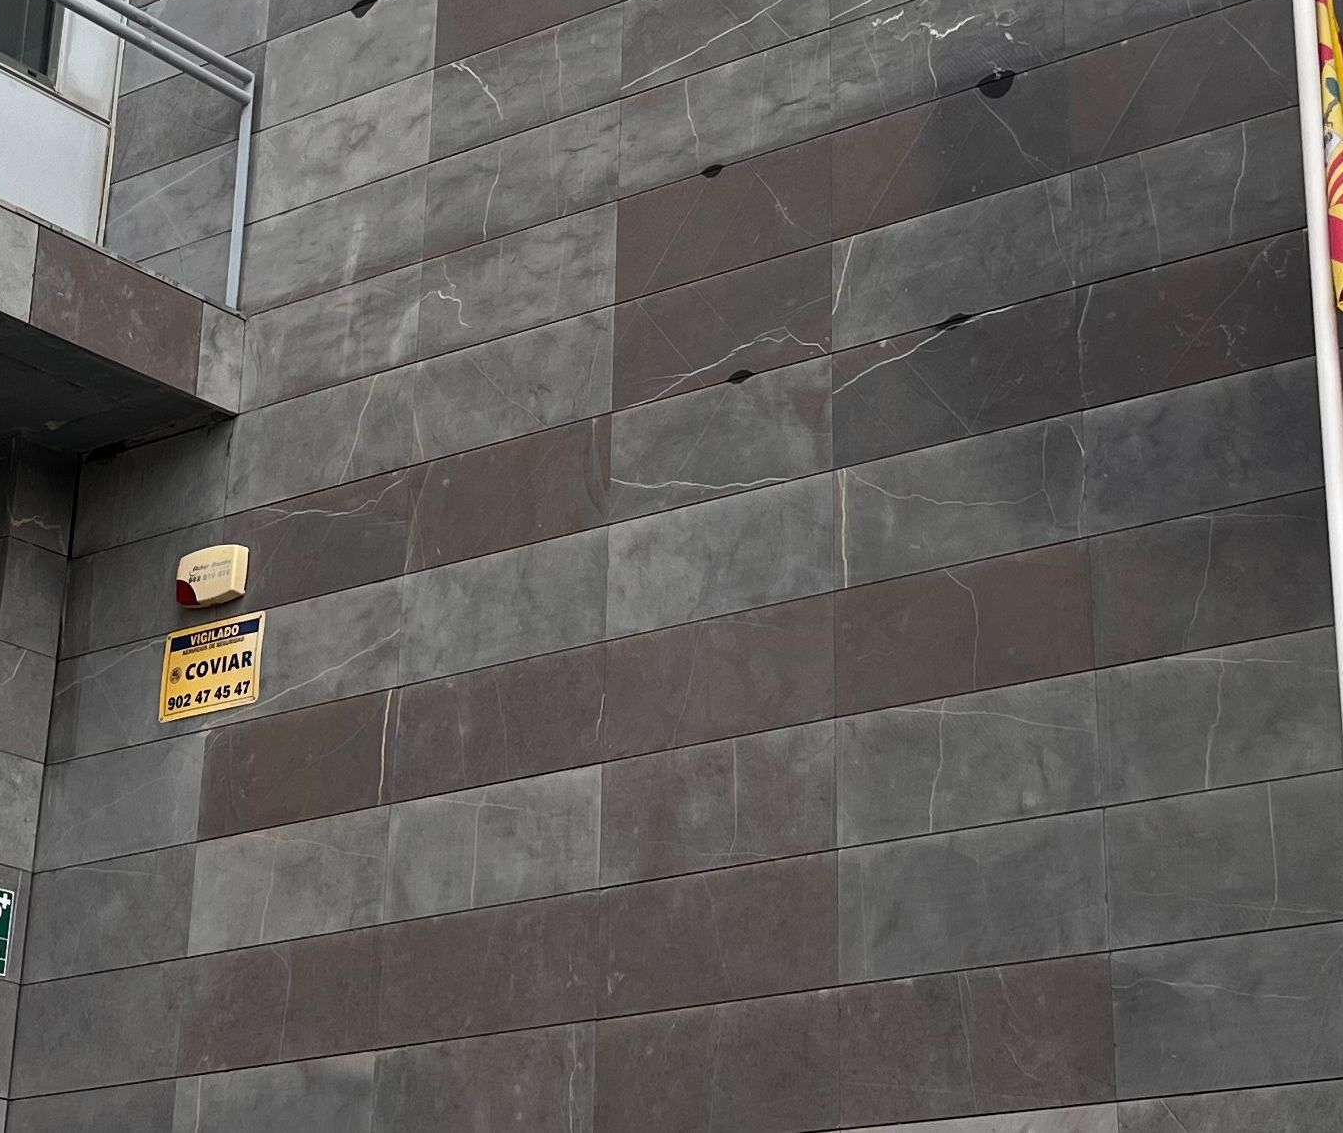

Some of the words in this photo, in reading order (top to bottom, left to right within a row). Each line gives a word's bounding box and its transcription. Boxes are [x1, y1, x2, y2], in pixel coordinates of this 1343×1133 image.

[190, 624, 240, 646] VIGILADO
[185, 650, 253, 681] COVIAR
[167, 693, 191, 711] 902
[194, 689, 211, 704] 47
[214, 684, 231, 700] 45
[234, 680, 251, 696] 47
